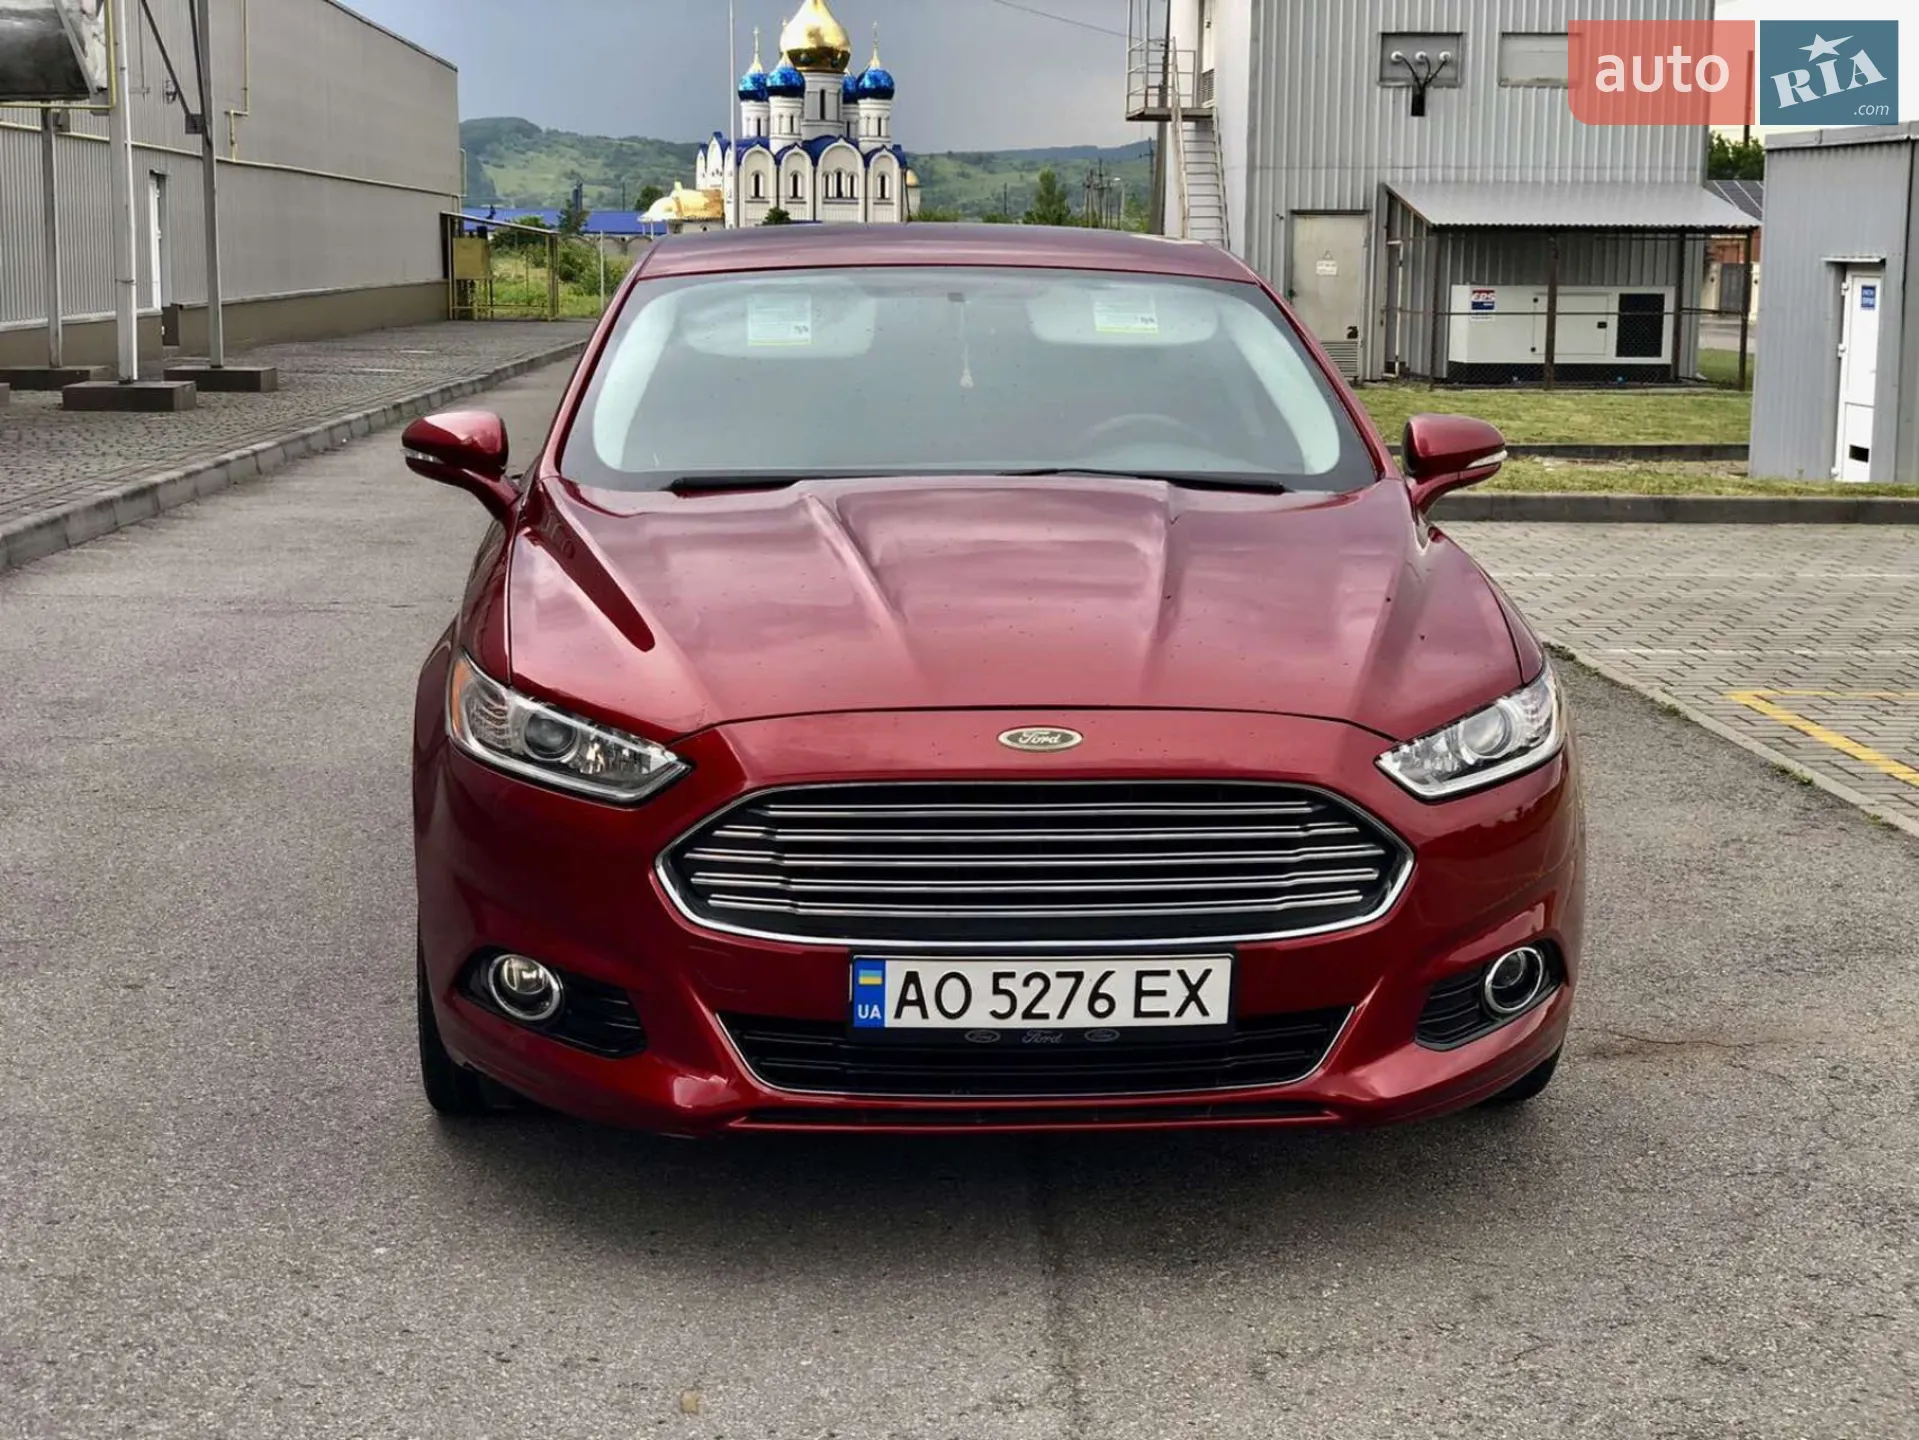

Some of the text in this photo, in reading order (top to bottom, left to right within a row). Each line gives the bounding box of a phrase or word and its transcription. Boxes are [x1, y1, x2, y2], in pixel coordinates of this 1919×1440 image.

[1018, 731, 1061, 744] Ford
[894, 968, 1213, 1020] AO 5276 EX
[858, 1004, 882, 1019] UA
[1021, 1029, 1063, 1044] Ford
